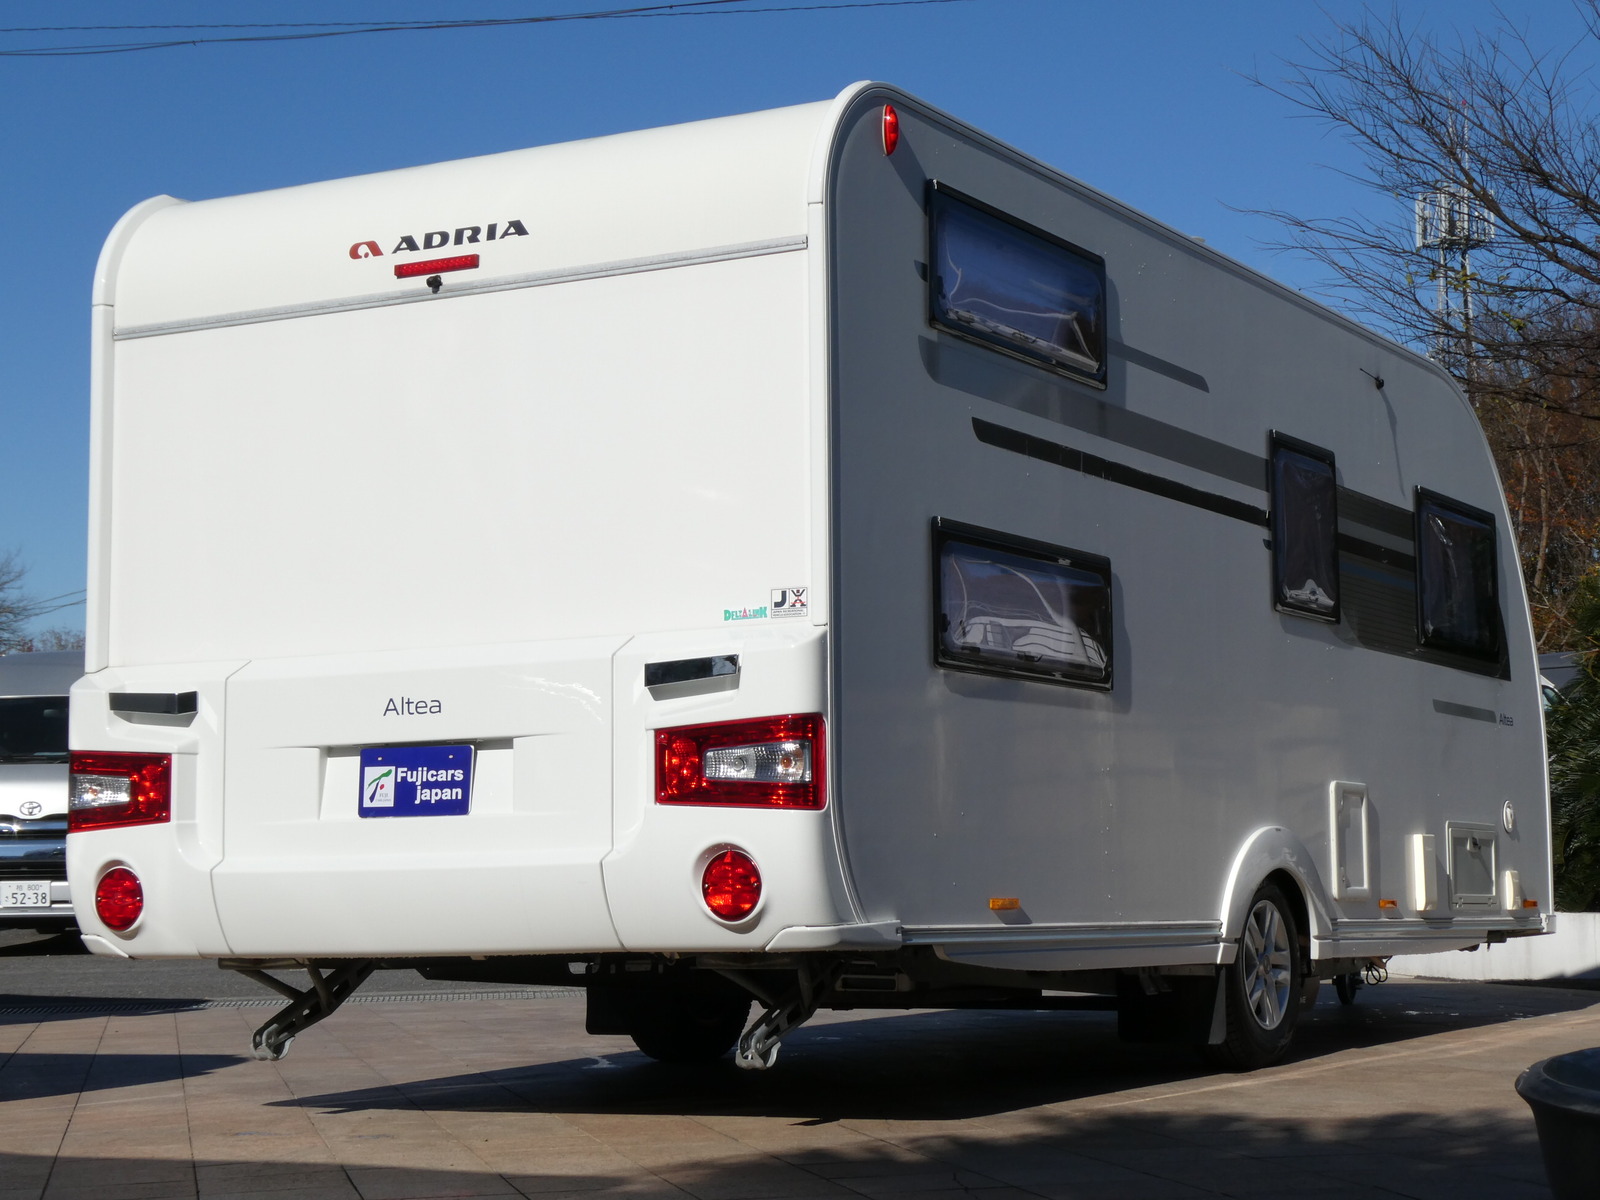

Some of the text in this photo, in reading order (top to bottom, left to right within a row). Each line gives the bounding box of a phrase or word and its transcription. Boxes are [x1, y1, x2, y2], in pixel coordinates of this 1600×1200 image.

[391, 219, 530, 254] ADRIA
[383, 696, 442, 716] Altea
[1499, 712, 1514, 726] Altea
[396, 767, 464, 786] Fujicars
[414, 785, 462, 804] japan
[11, 892, 47, 904] 52-38
